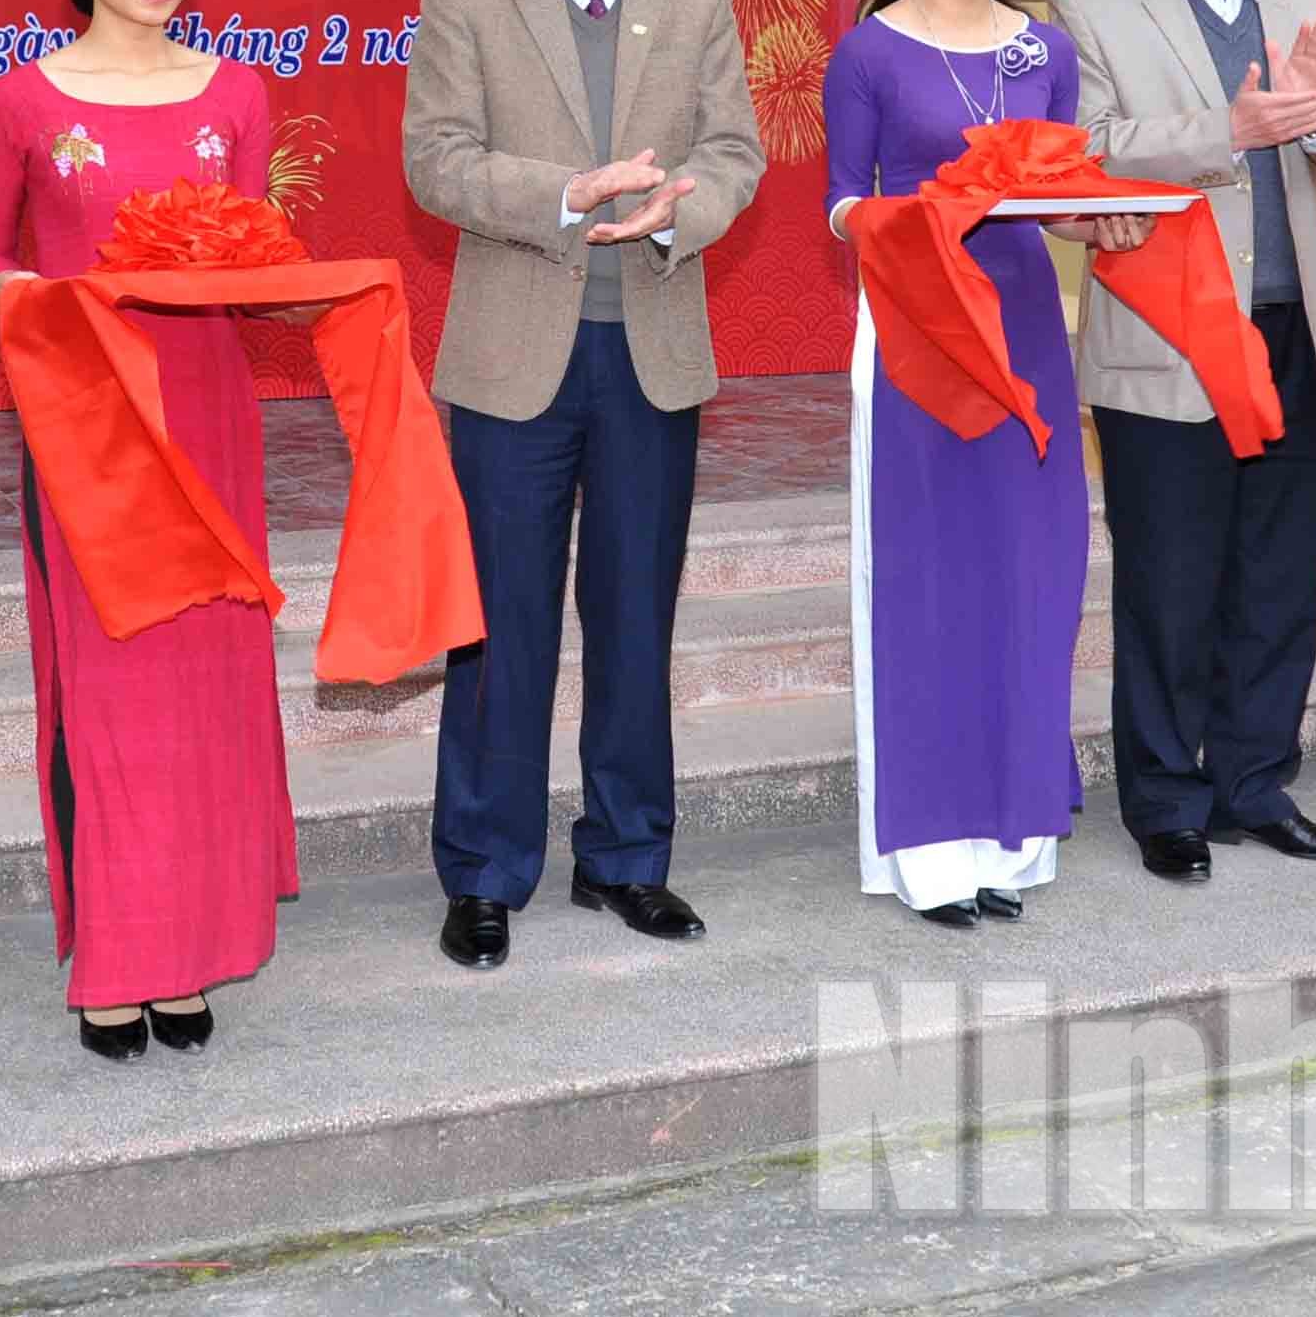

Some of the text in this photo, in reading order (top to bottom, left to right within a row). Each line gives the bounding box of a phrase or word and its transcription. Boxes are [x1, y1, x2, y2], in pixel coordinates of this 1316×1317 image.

[165, 12, 309, 78] tháng
[318, 14, 350, 65] 2
[361, 15, 423, 66] nă
